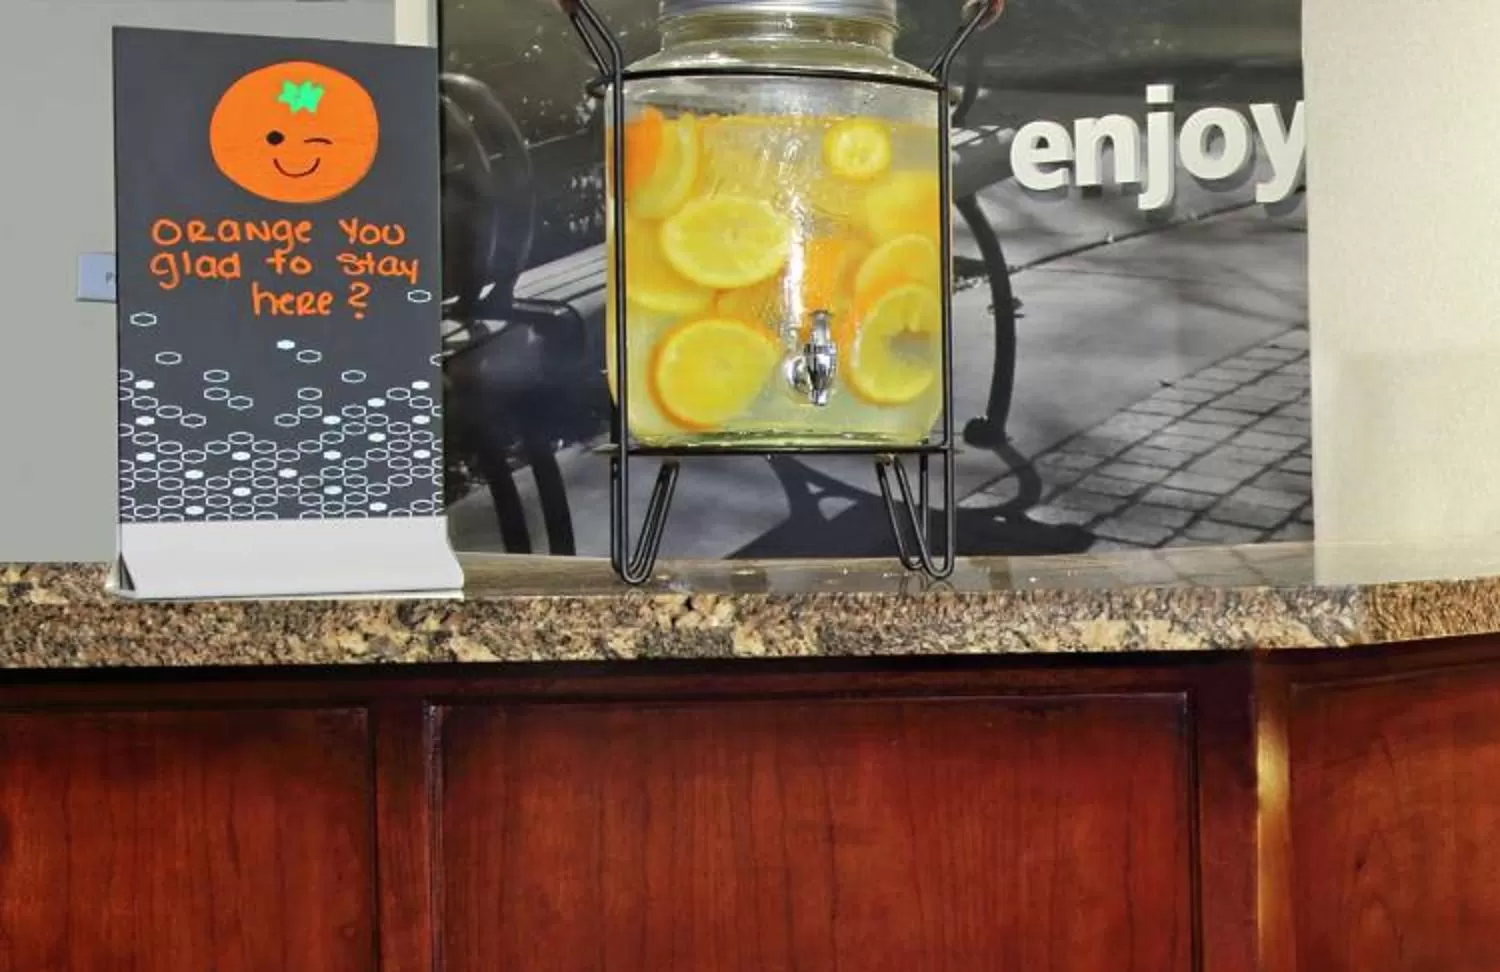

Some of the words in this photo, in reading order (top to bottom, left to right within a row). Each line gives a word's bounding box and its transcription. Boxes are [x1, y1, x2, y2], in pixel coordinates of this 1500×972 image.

[1009, 83, 1306, 211] enjoy
[149, 252, 241, 290] glad
[265, 250, 313, 275] to
